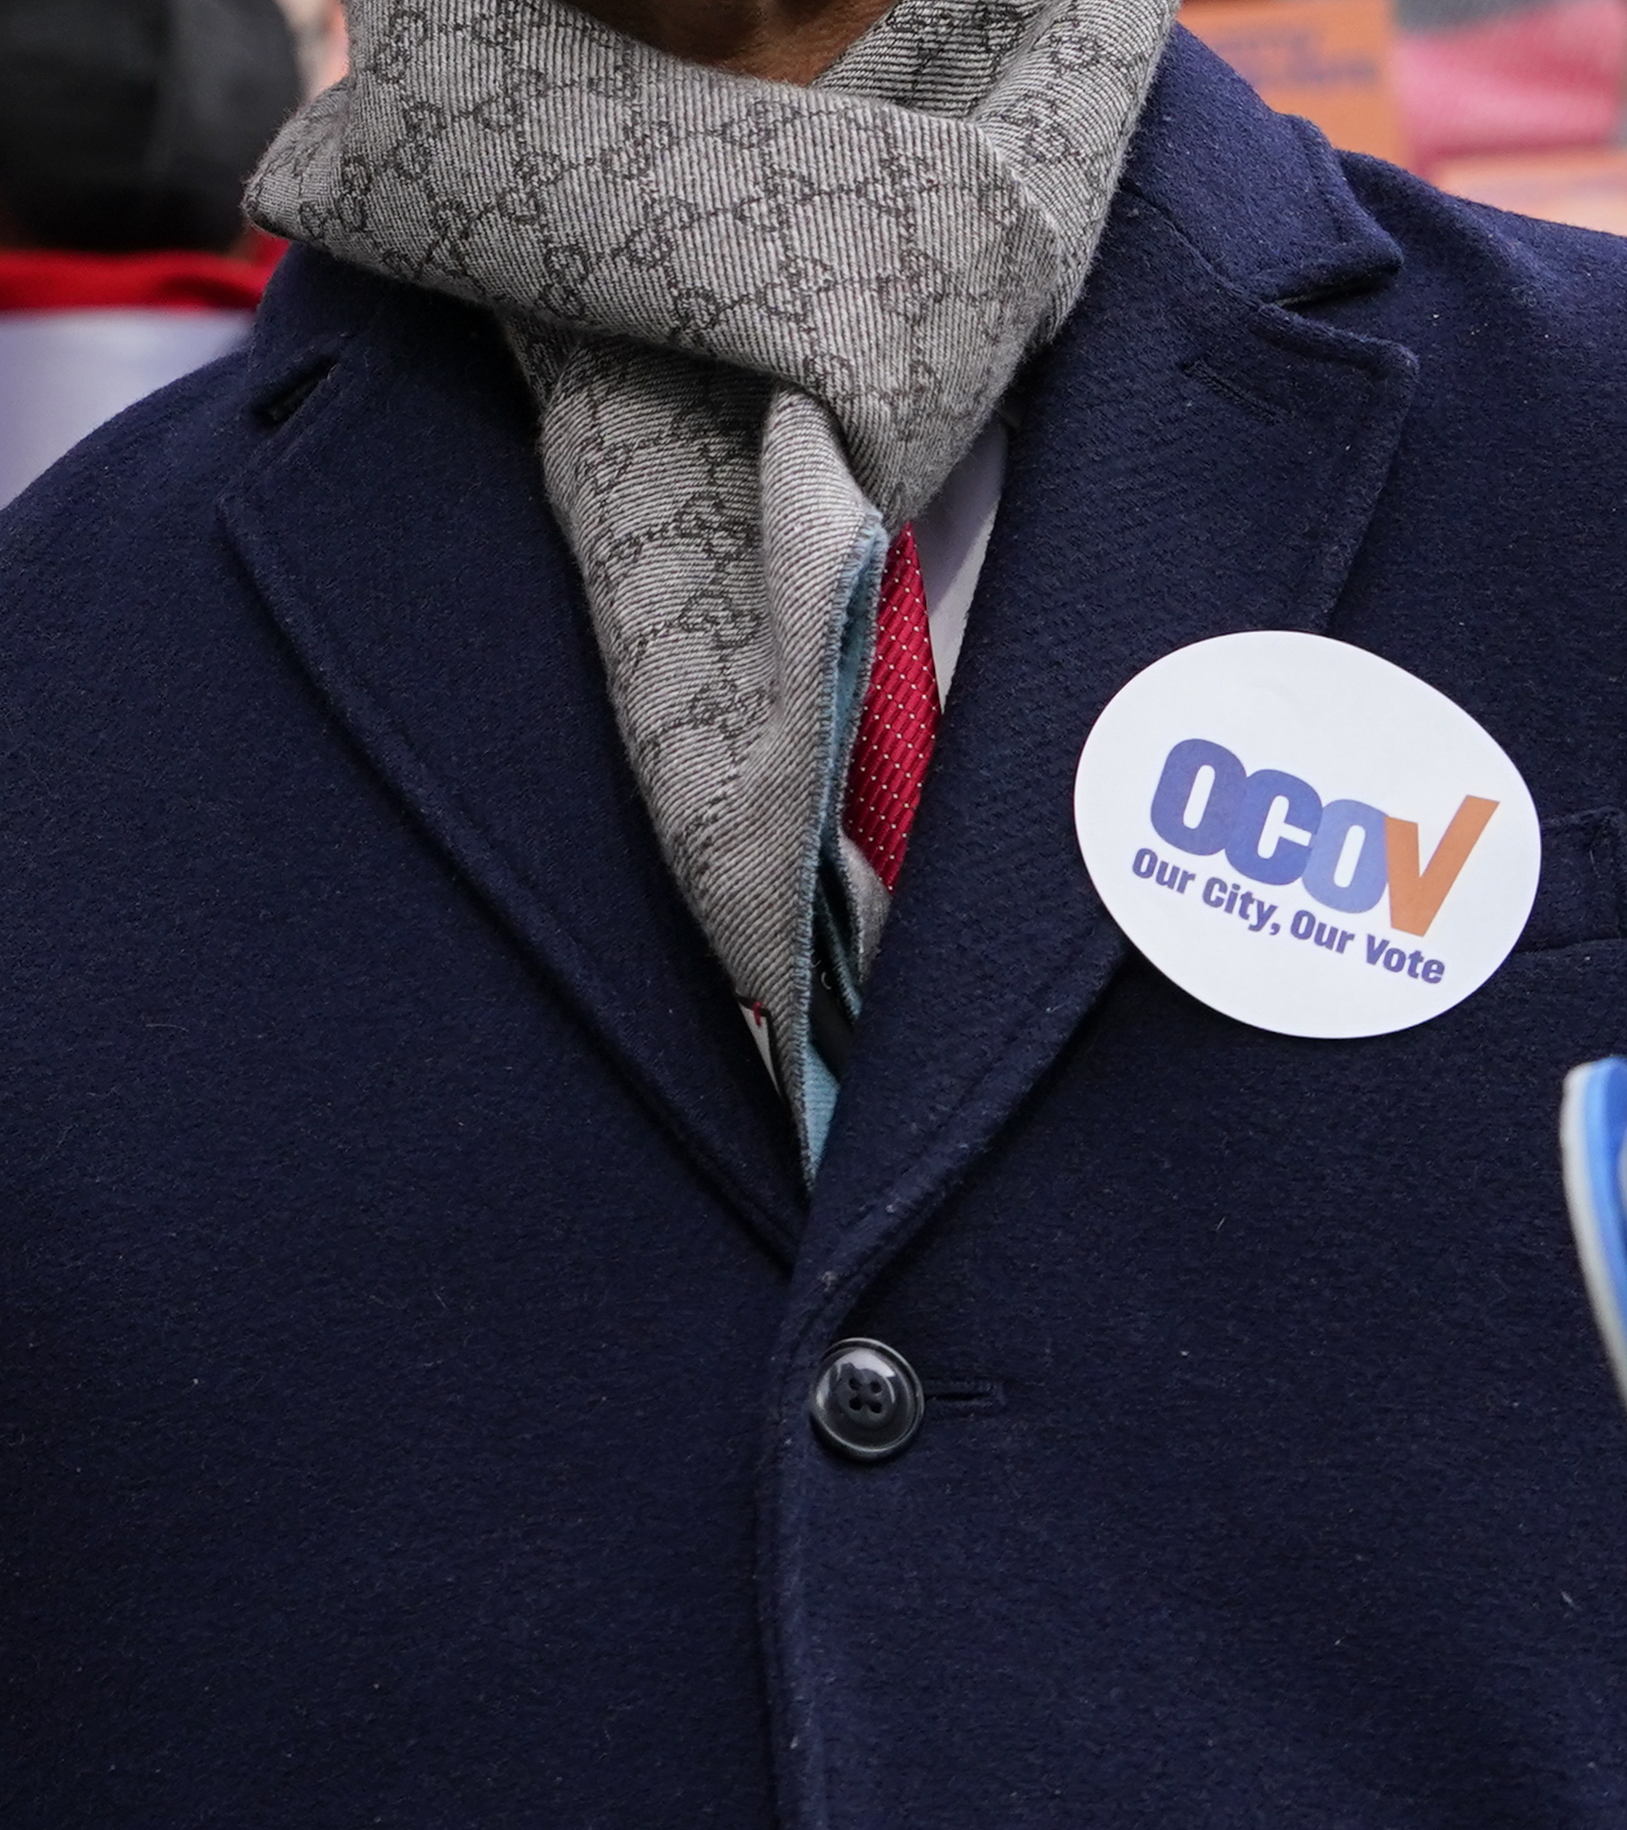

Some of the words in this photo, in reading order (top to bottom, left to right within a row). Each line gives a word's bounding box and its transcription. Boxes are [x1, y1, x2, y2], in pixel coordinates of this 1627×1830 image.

[1132, 847, 1195, 895] Our
[1203, 876, 1281, 936] City,
[1290, 909, 1354, 954] Our
[1365, 934, 1445, 985] Vote
[1150, 738, 1500, 938] OCOV
